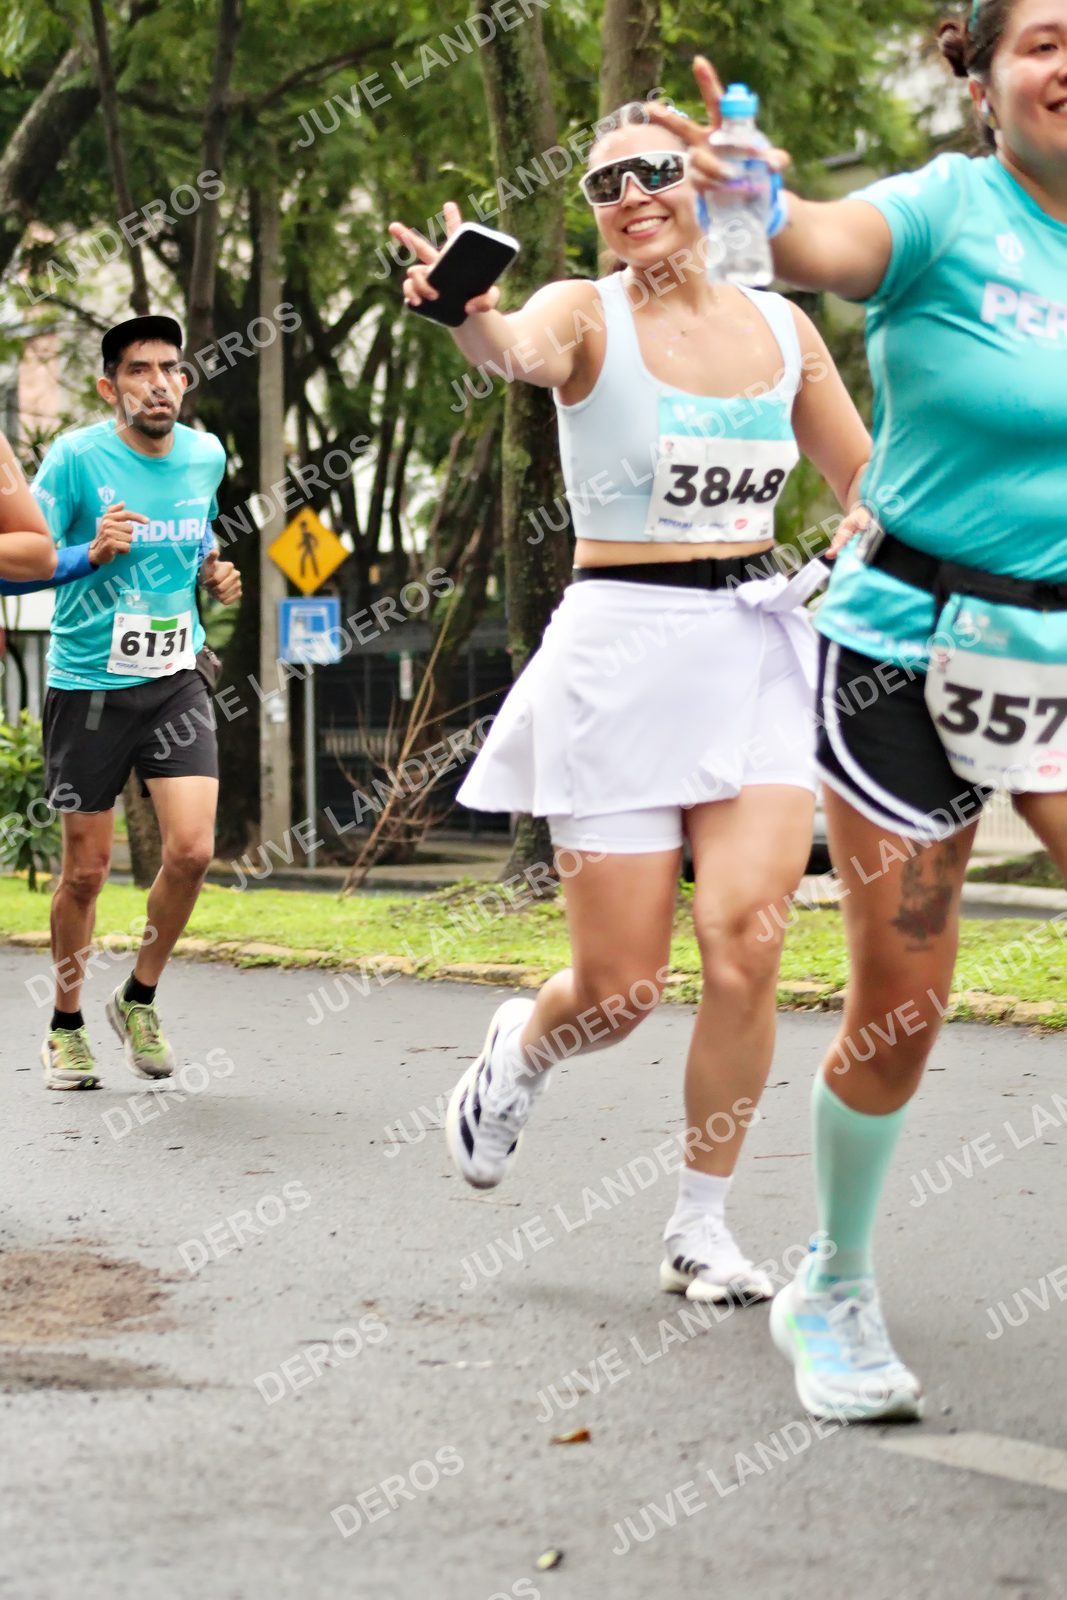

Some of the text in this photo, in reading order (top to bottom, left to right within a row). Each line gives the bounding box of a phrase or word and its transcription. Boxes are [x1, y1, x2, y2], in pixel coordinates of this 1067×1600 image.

[664, 464, 785, 507] 3848
[96, 516, 206, 542] RDUR
[121, 628, 187, 657] 6131
[937, 682, 1067, 745] 357
